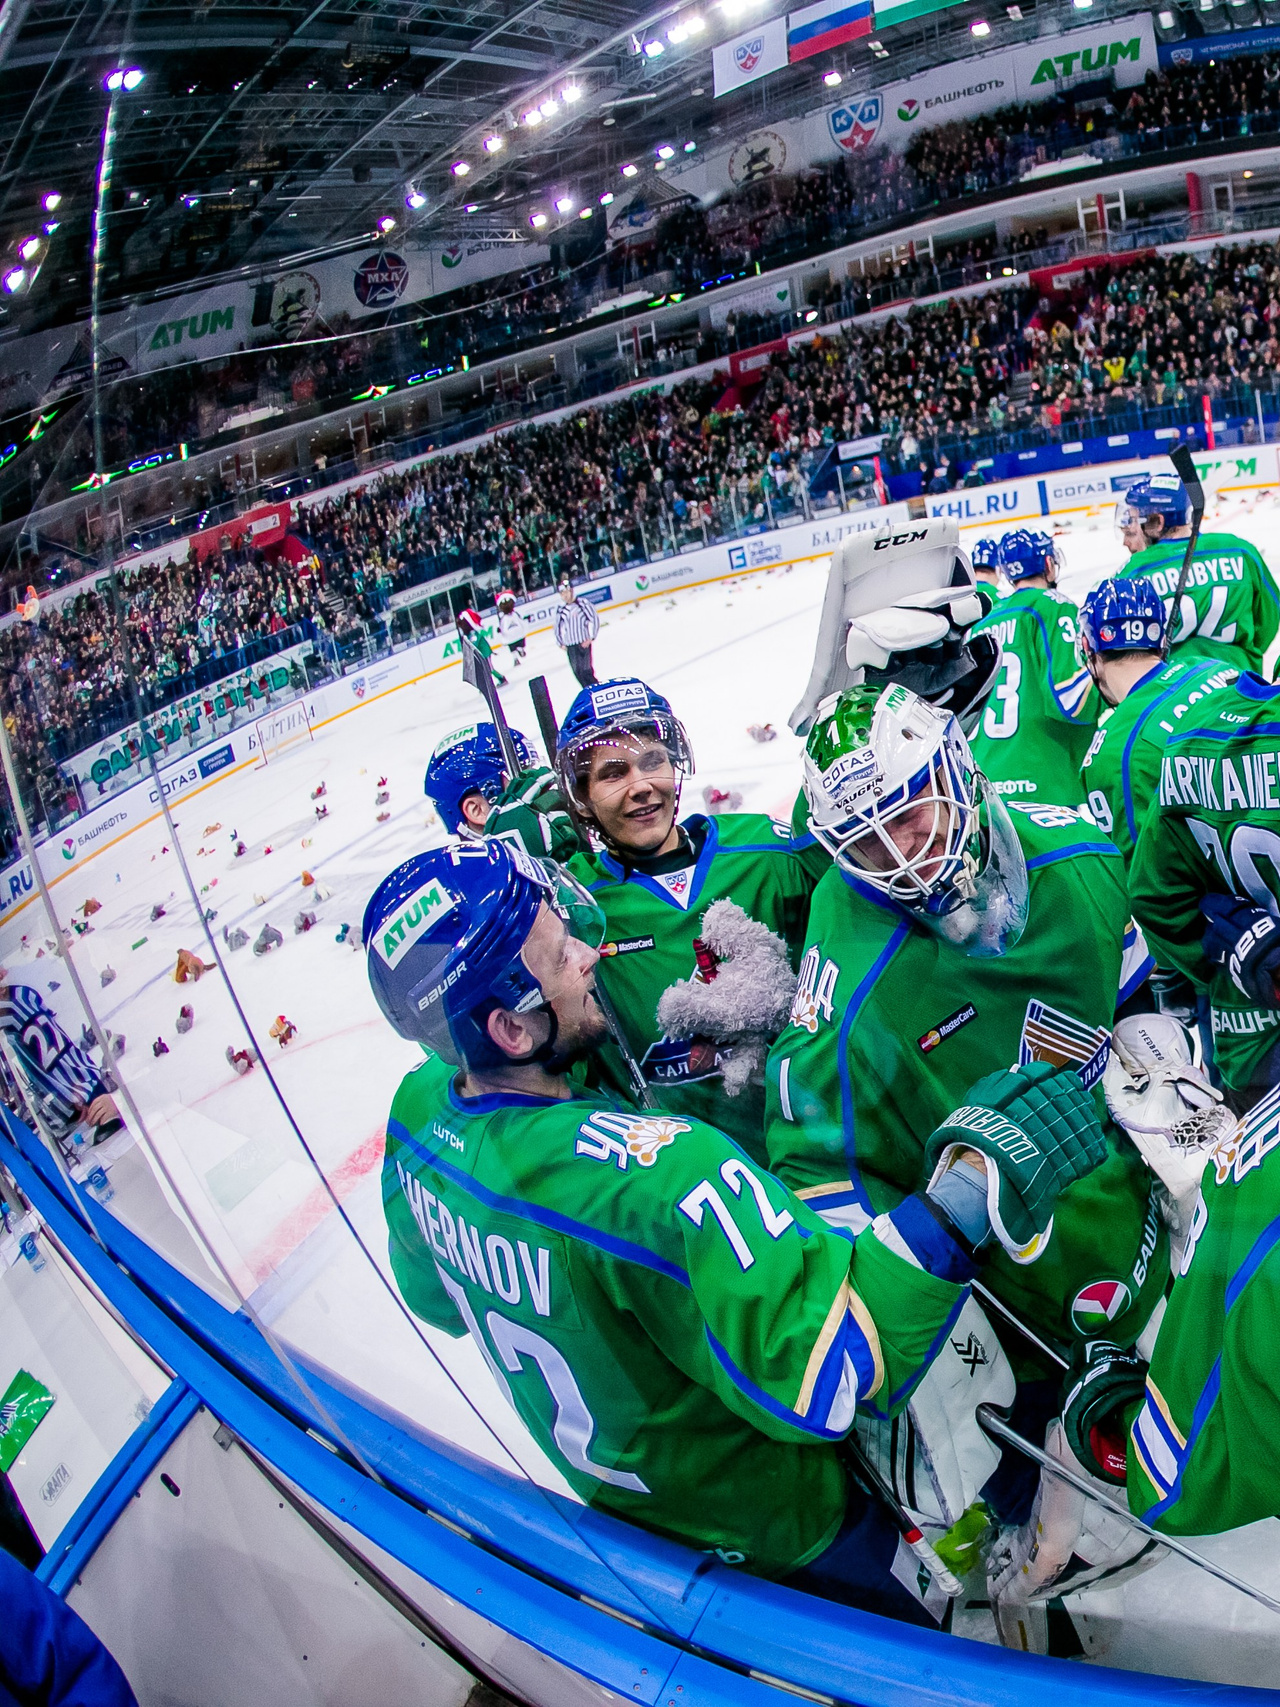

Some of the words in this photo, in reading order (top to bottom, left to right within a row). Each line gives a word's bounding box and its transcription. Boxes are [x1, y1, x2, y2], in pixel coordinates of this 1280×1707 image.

[1030, 37, 1142, 86] ATUM
[924, 79, 1005, 110] БАШНЕФТЬ
[366, 269, 401, 286] МХЛ
[151, 306, 236, 350] ATUM
[932, 491, 1019, 519] KHL.RU
[1053, 483, 1107, 499] СОГАЗ
[874, 529, 929, 551] CCM
[649, 565, 694, 585] БАШНЕФТЬ
[1008, 560, 1024, 577] 33
[402, 586, 431, 603] САЛАВАТ
[443, 626, 494, 659] ATM
[1057, 616, 1076, 643] 3
[1121, 620, 1144, 642] 19
[1161, 663, 1185, 681] LUTCH
[594, 685, 644, 705] СОГАЗ
[886, 685, 911, 716] ATUM
[984, 651, 1022, 740] 3
[437, 726, 475, 751] ATUM
[826, 719, 841, 746] 1
[821, 749, 876, 790] СОГАЗ
[149, 768, 198, 804] СОГАЗ
[835, 774, 885, 810] VAUGHN
[77, 811, 128, 848] БАШНЕФТЬ
[383, 887, 442, 961] ATUM
[618, 938, 654, 952] MasterCard
[1230, 914, 1277, 999] BAU
[418, 960, 468, 1011] BAUER
[518, 991, 541, 1012] BAUER
[940, 1006, 976, 1037] MasterCard
[23, 1013, 68, 1071] 27
[655, 1048, 733, 1077] САЛАТ
[1080, 1046, 1108, 1086] ЛАЕВ
[779, 1056, 795, 1122] 1
[432, 1122, 465, 1152] LUTCH
[678, 1158, 797, 1273] 72
[396, 1159, 553, 1319] CHERNOV
[436, 1266, 653, 1495] 72
